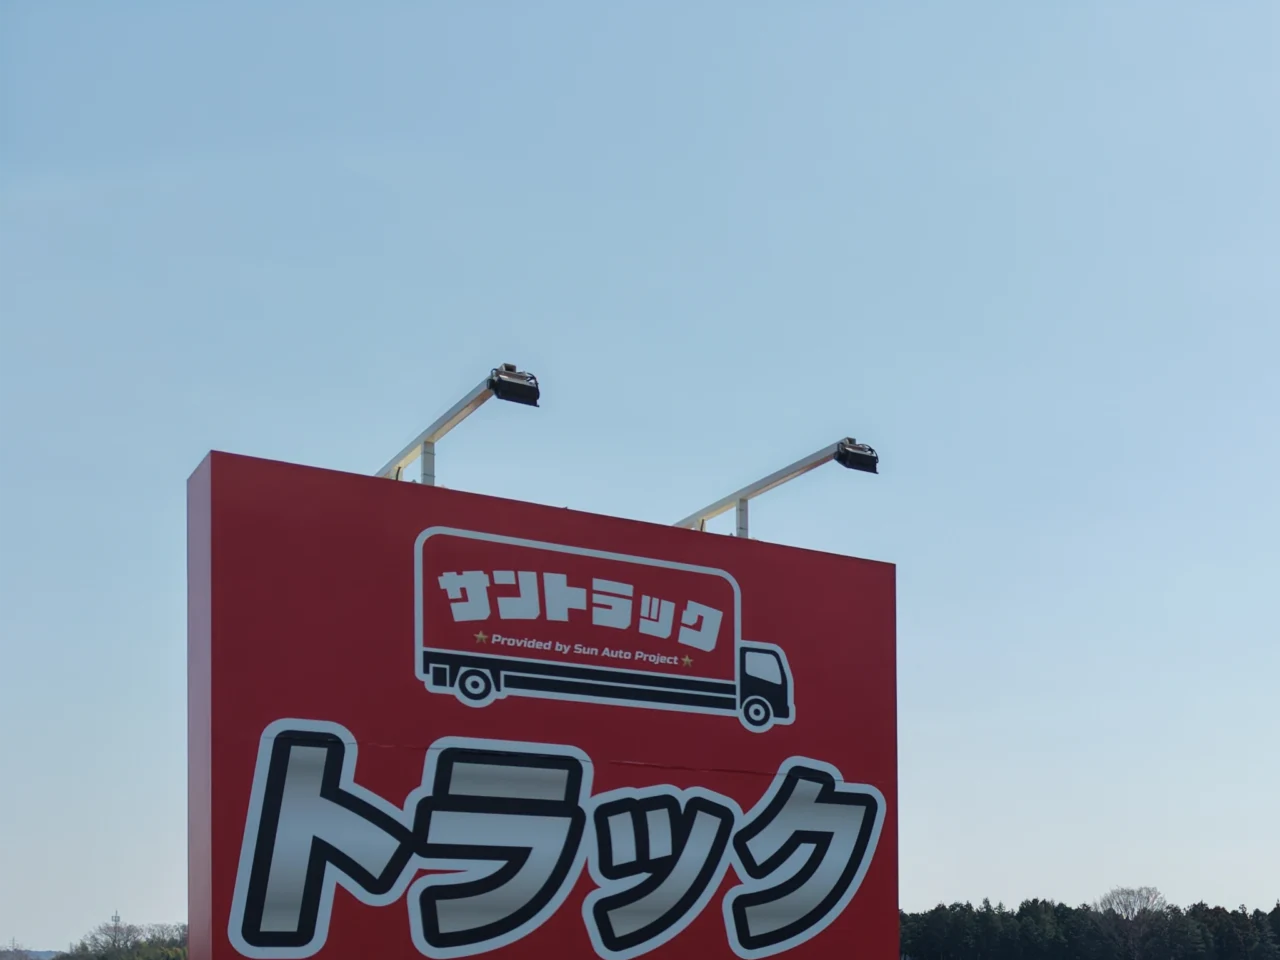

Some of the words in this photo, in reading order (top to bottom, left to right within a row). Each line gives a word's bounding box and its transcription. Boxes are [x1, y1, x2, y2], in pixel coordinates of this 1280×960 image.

[437, 569, 723, 653] サントラック
[491, 634, 551, 650] Provided
[555, 641, 571, 654] by
[573, 644, 599, 656] Sun
[601, 647, 632, 660] Auto
[634, 651, 679, 665] Project
[236, 724, 882, 956] トラック
